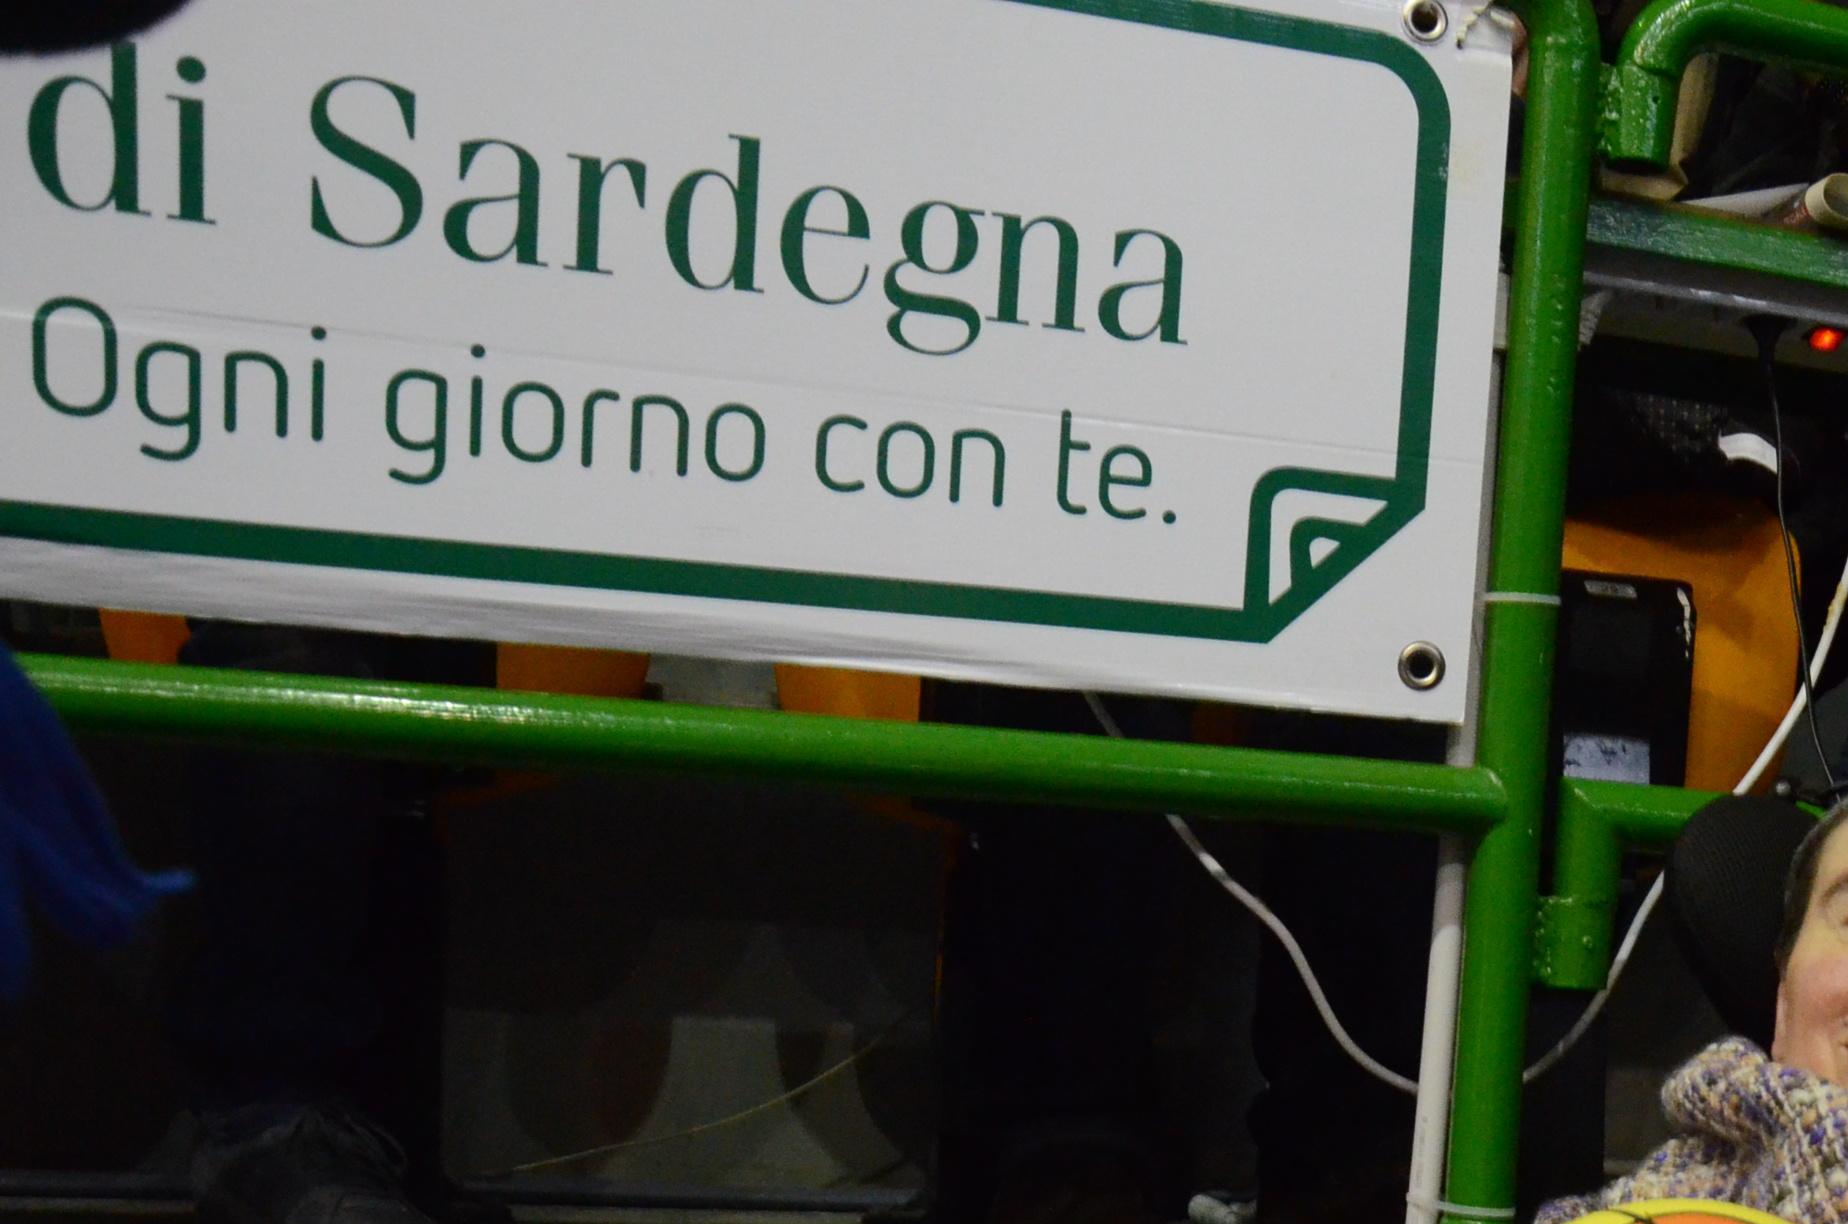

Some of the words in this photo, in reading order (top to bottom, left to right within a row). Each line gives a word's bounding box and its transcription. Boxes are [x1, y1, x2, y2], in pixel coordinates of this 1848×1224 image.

[26, 43, 217, 225] di
[309, 75, 1188, 356] Sardegna
[31, 296, 327, 462] Ogni
[384, 343, 767, 485] giorno
[814, 414, 1006, 506] con
[1056, 409, 1177, 524] te.
